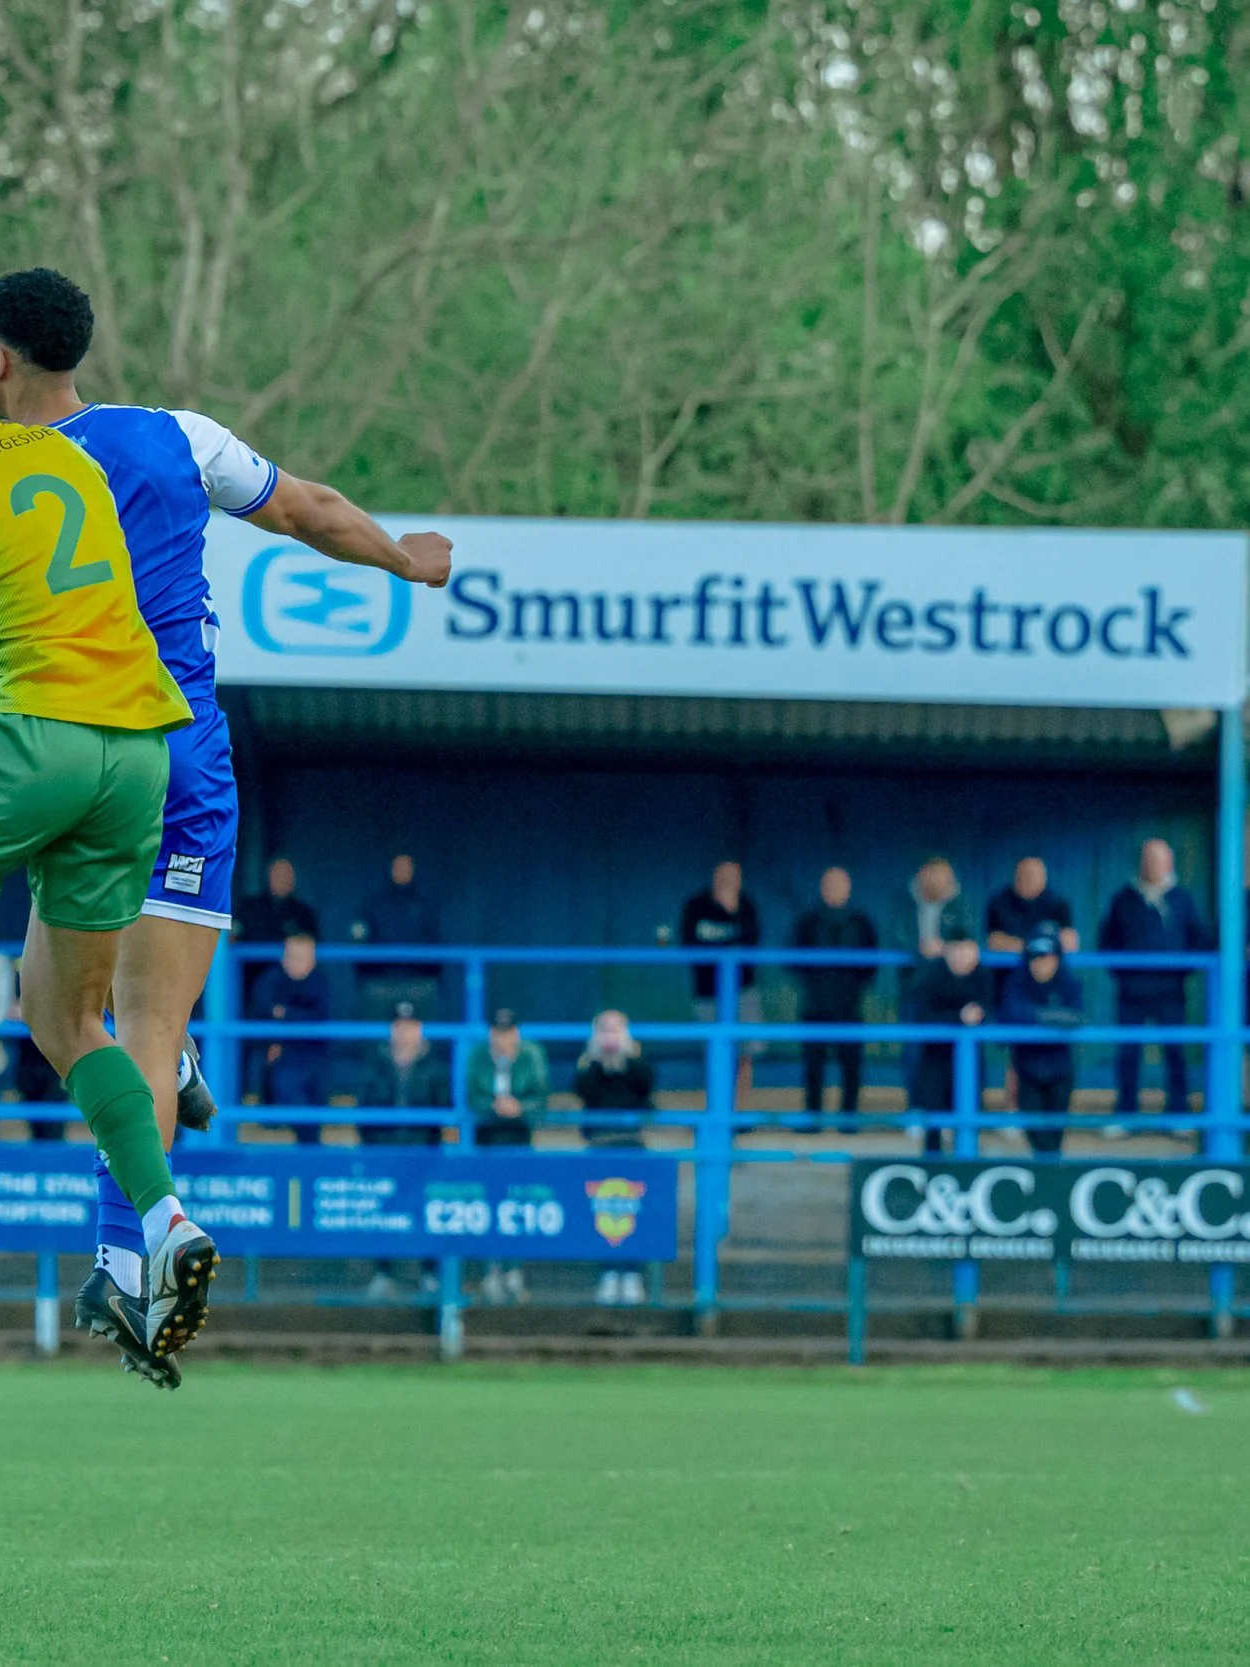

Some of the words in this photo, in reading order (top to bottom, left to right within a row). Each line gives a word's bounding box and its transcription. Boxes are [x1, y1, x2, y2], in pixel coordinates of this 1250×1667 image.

[10, 473, 113, 596] 2
[447, 567, 1193, 661] SmurfitWestrock
[426, 1200, 490, 1236] £20
[497, 1200, 564, 1237] £10
[861, 1164, 1058, 1237] C&C.
